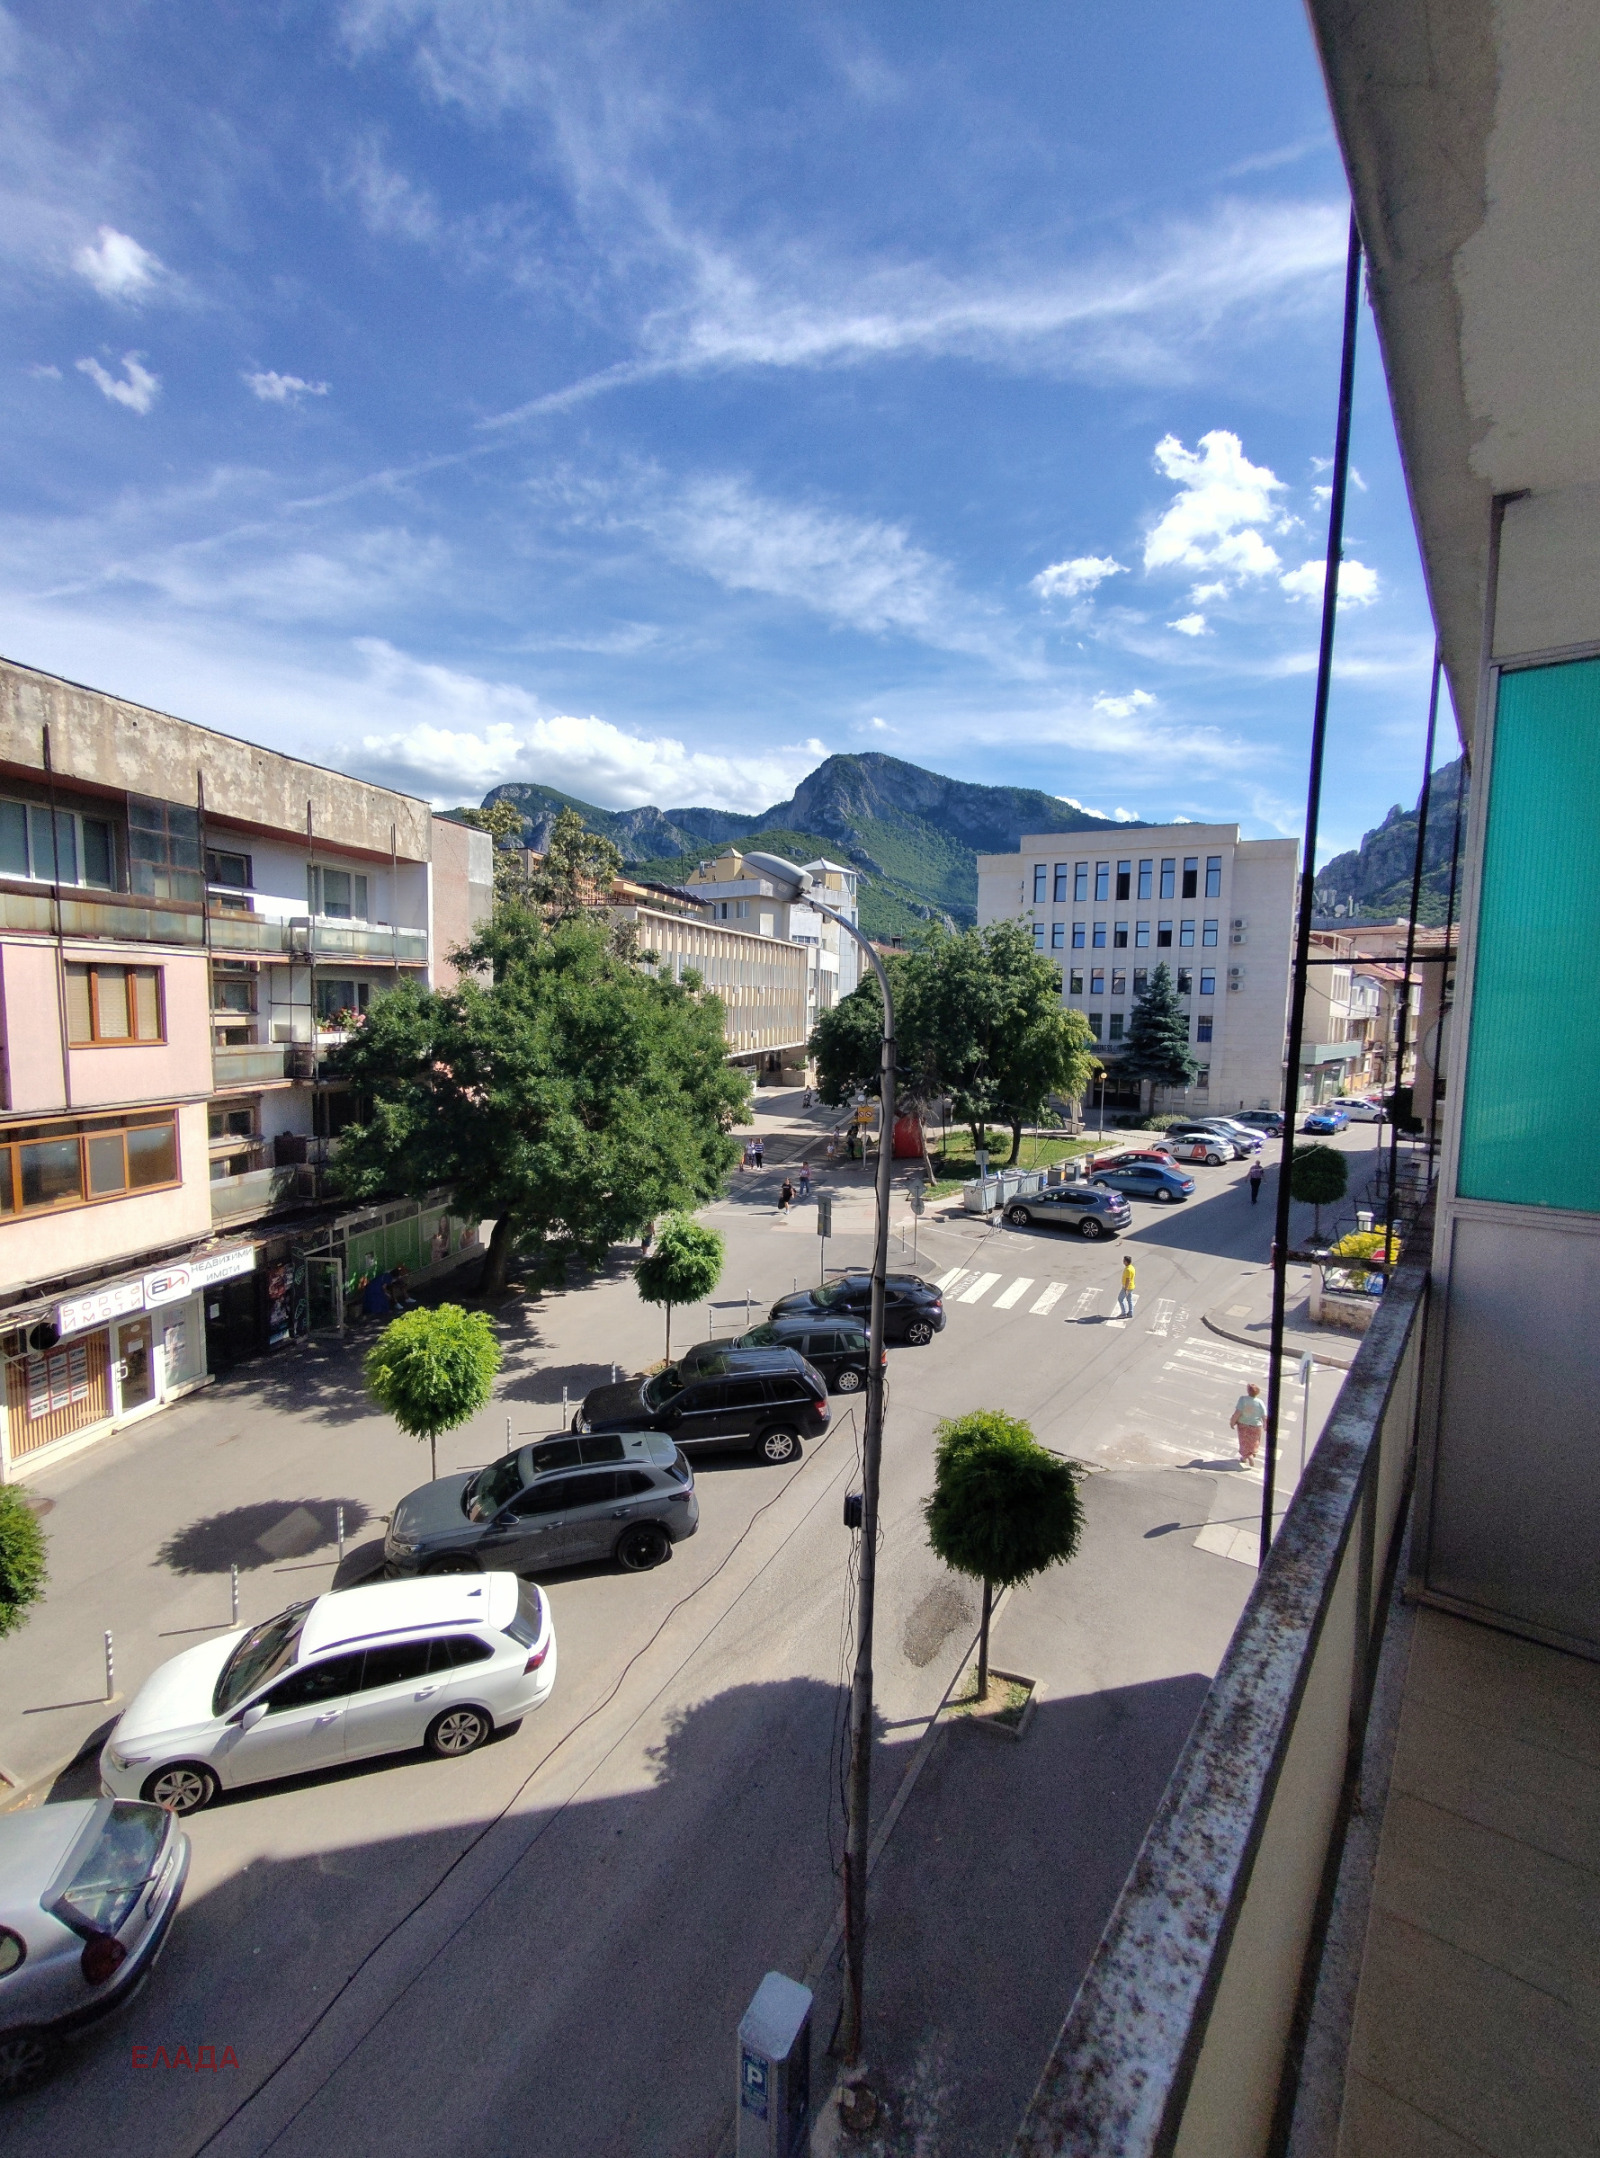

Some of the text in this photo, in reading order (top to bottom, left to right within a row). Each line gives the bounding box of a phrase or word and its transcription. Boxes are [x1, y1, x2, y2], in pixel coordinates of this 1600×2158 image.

[191, 1247, 253, 1273] НЕДВИЖИМИ
[206, 1264, 240, 1282] ИМОТИ
[151, 1276, 185, 1296] БИ
[64, 1297, 141, 1330] ИМОТИ
[747, 2063, 763, 2085] P
